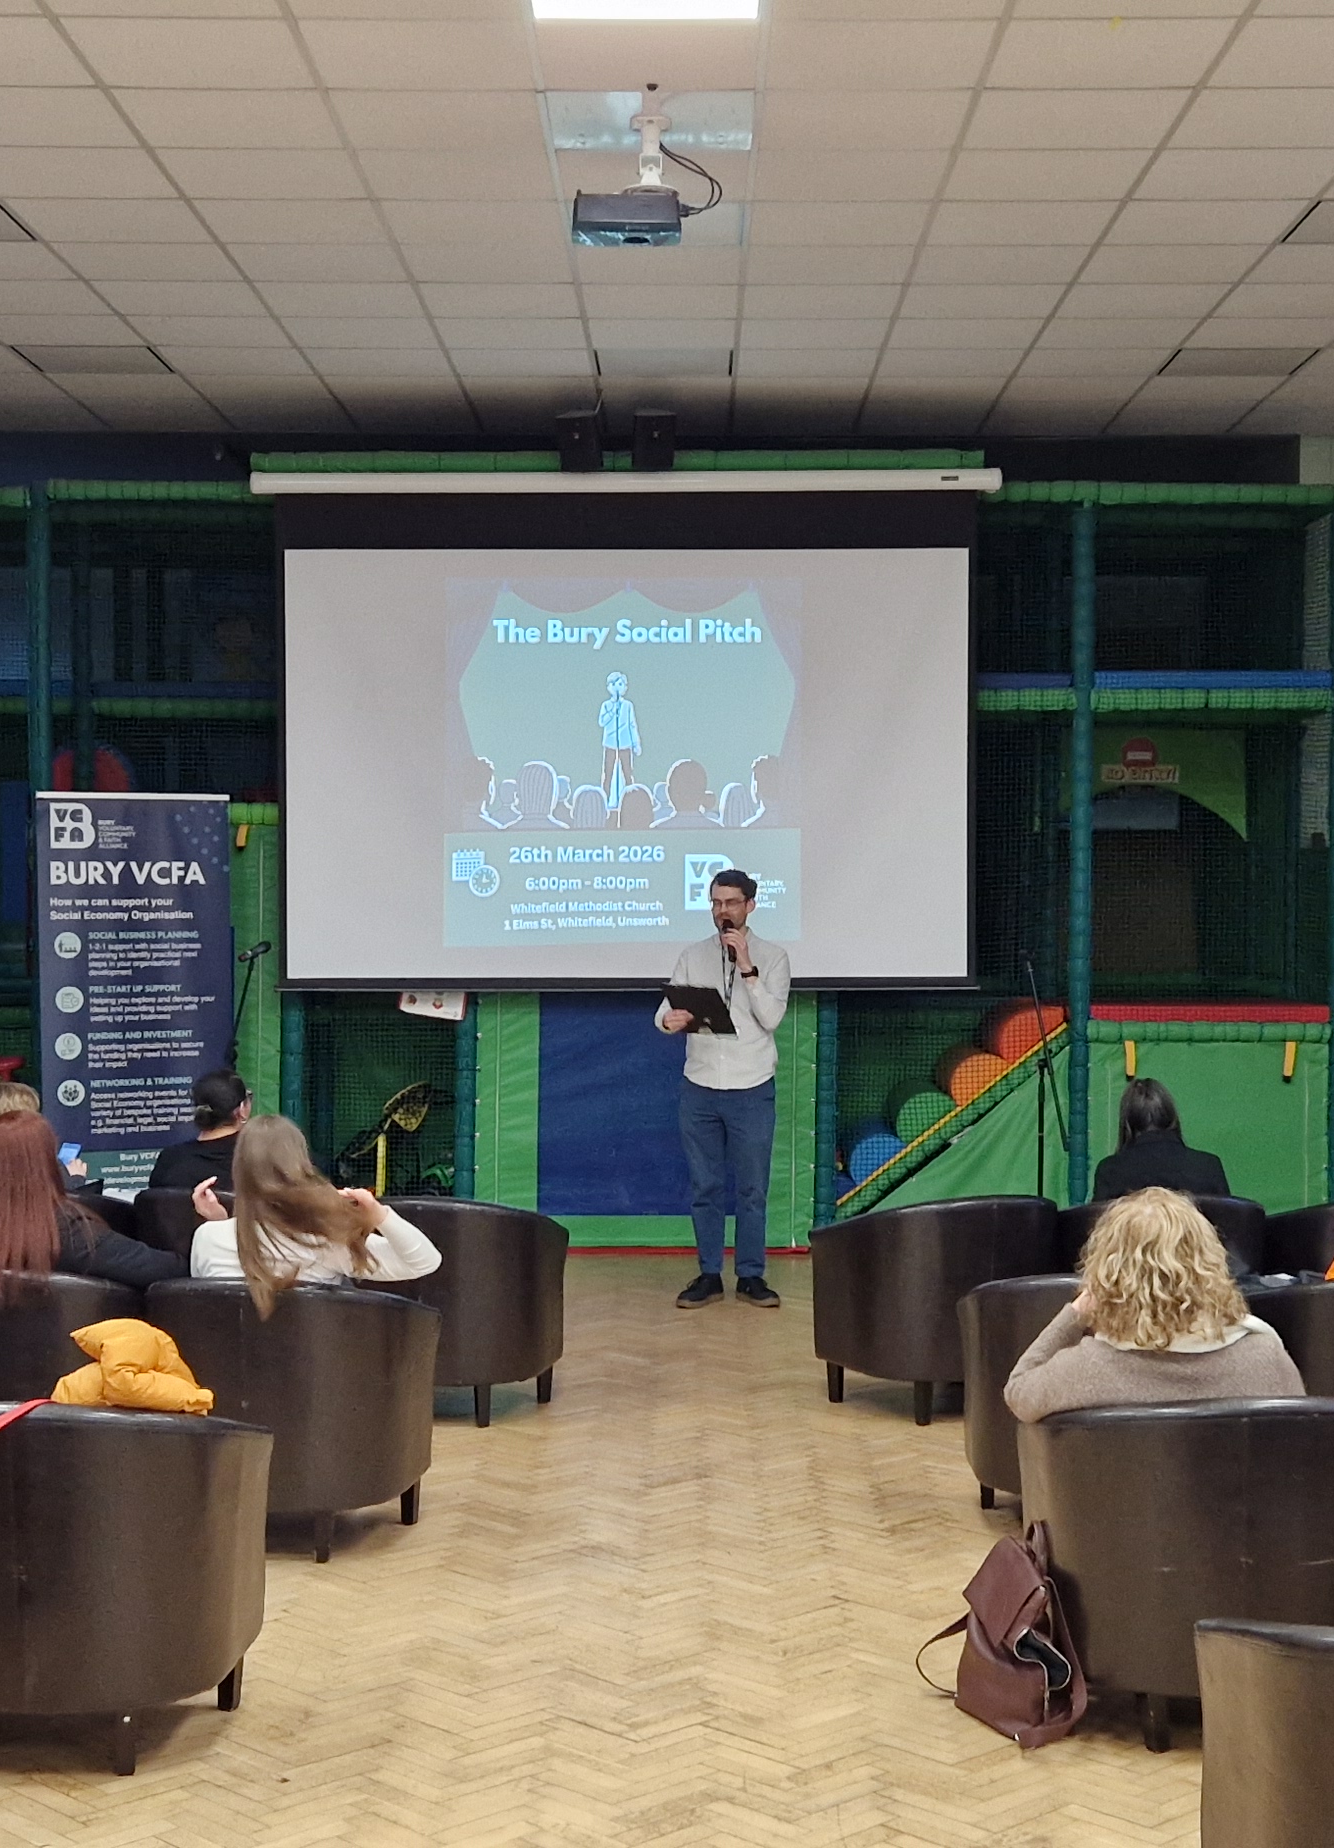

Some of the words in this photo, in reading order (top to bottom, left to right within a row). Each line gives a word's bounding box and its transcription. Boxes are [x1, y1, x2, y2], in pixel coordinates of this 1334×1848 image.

[493, 619, 541, 643] The
[547, 619, 610, 650] Bury
[615, 619, 692, 643] Social
[699, 619, 762, 643] Pitch
[509, 846, 552, 863] 26th
[557, 845, 614, 863] March
[618, 846, 665, 862] 2026
[50, 861, 126, 885] BURY
[129, 861, 206, 885] VCFA
[525, 877, 582, 892] 6:00pm
[593, 876, 649, 892] 8:00pm
[50, 898, 72, 906] How
[111, 898, 149, 907] support
[150, 899, 173, 908] your
[510, 902, 566, 914] Whitefield
[568, 901, 623, 913] Methodist
[625, 900, 663, 912] Church
[50, 911, 81, 920] Social
[83, 911, 129, 921] Economy
[131, 911, 193, 921] Organisation
[504, 920, 511, 930] 1
[513, 919, 539, 930] Elms
[541, 919, 556, 930] St,
[558, 916, 616, 929] Whitefield,
[618, 916, 669, 927] Unsworth
[119, 931, 156, 939] BUSINESS
[158, 931, 199, 939] PLANNING
[89, 985, 131, 993] PRE-START
[88, 1032, 123, 1040] FUNDING
[125, 1031, 142, 1039] AND
[143, 1030, 193, 1038] INVESTMENT
[91, 1079, 144, 1088] NETWORKING
[154, 1077, 192, 1085] TRAINING
[120, 1153, 138, 1162] Bury
